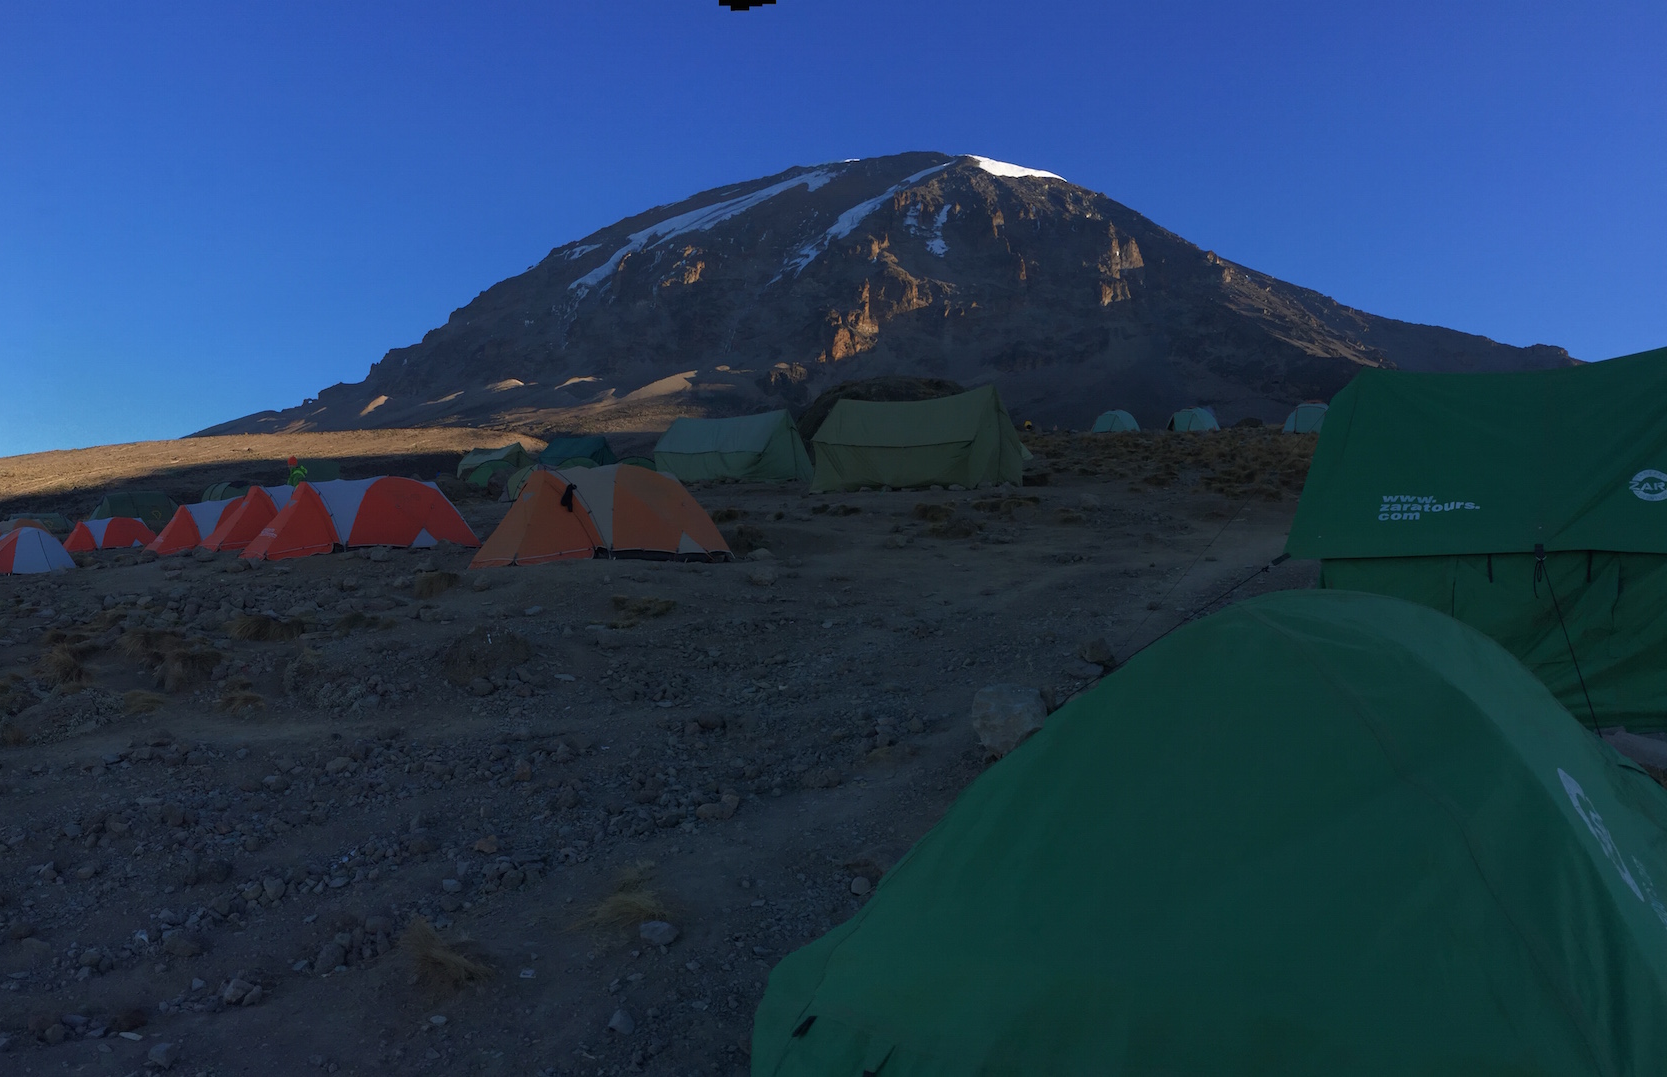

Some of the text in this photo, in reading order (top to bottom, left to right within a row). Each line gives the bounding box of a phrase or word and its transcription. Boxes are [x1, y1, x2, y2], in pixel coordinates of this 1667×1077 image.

[1629, 481, 1667, 491] ZAR
[1382, 495, 1437, 503] www.
[1379, 501, 1481, 512] zaratours.
[1377, 512, 1421, 521] com
